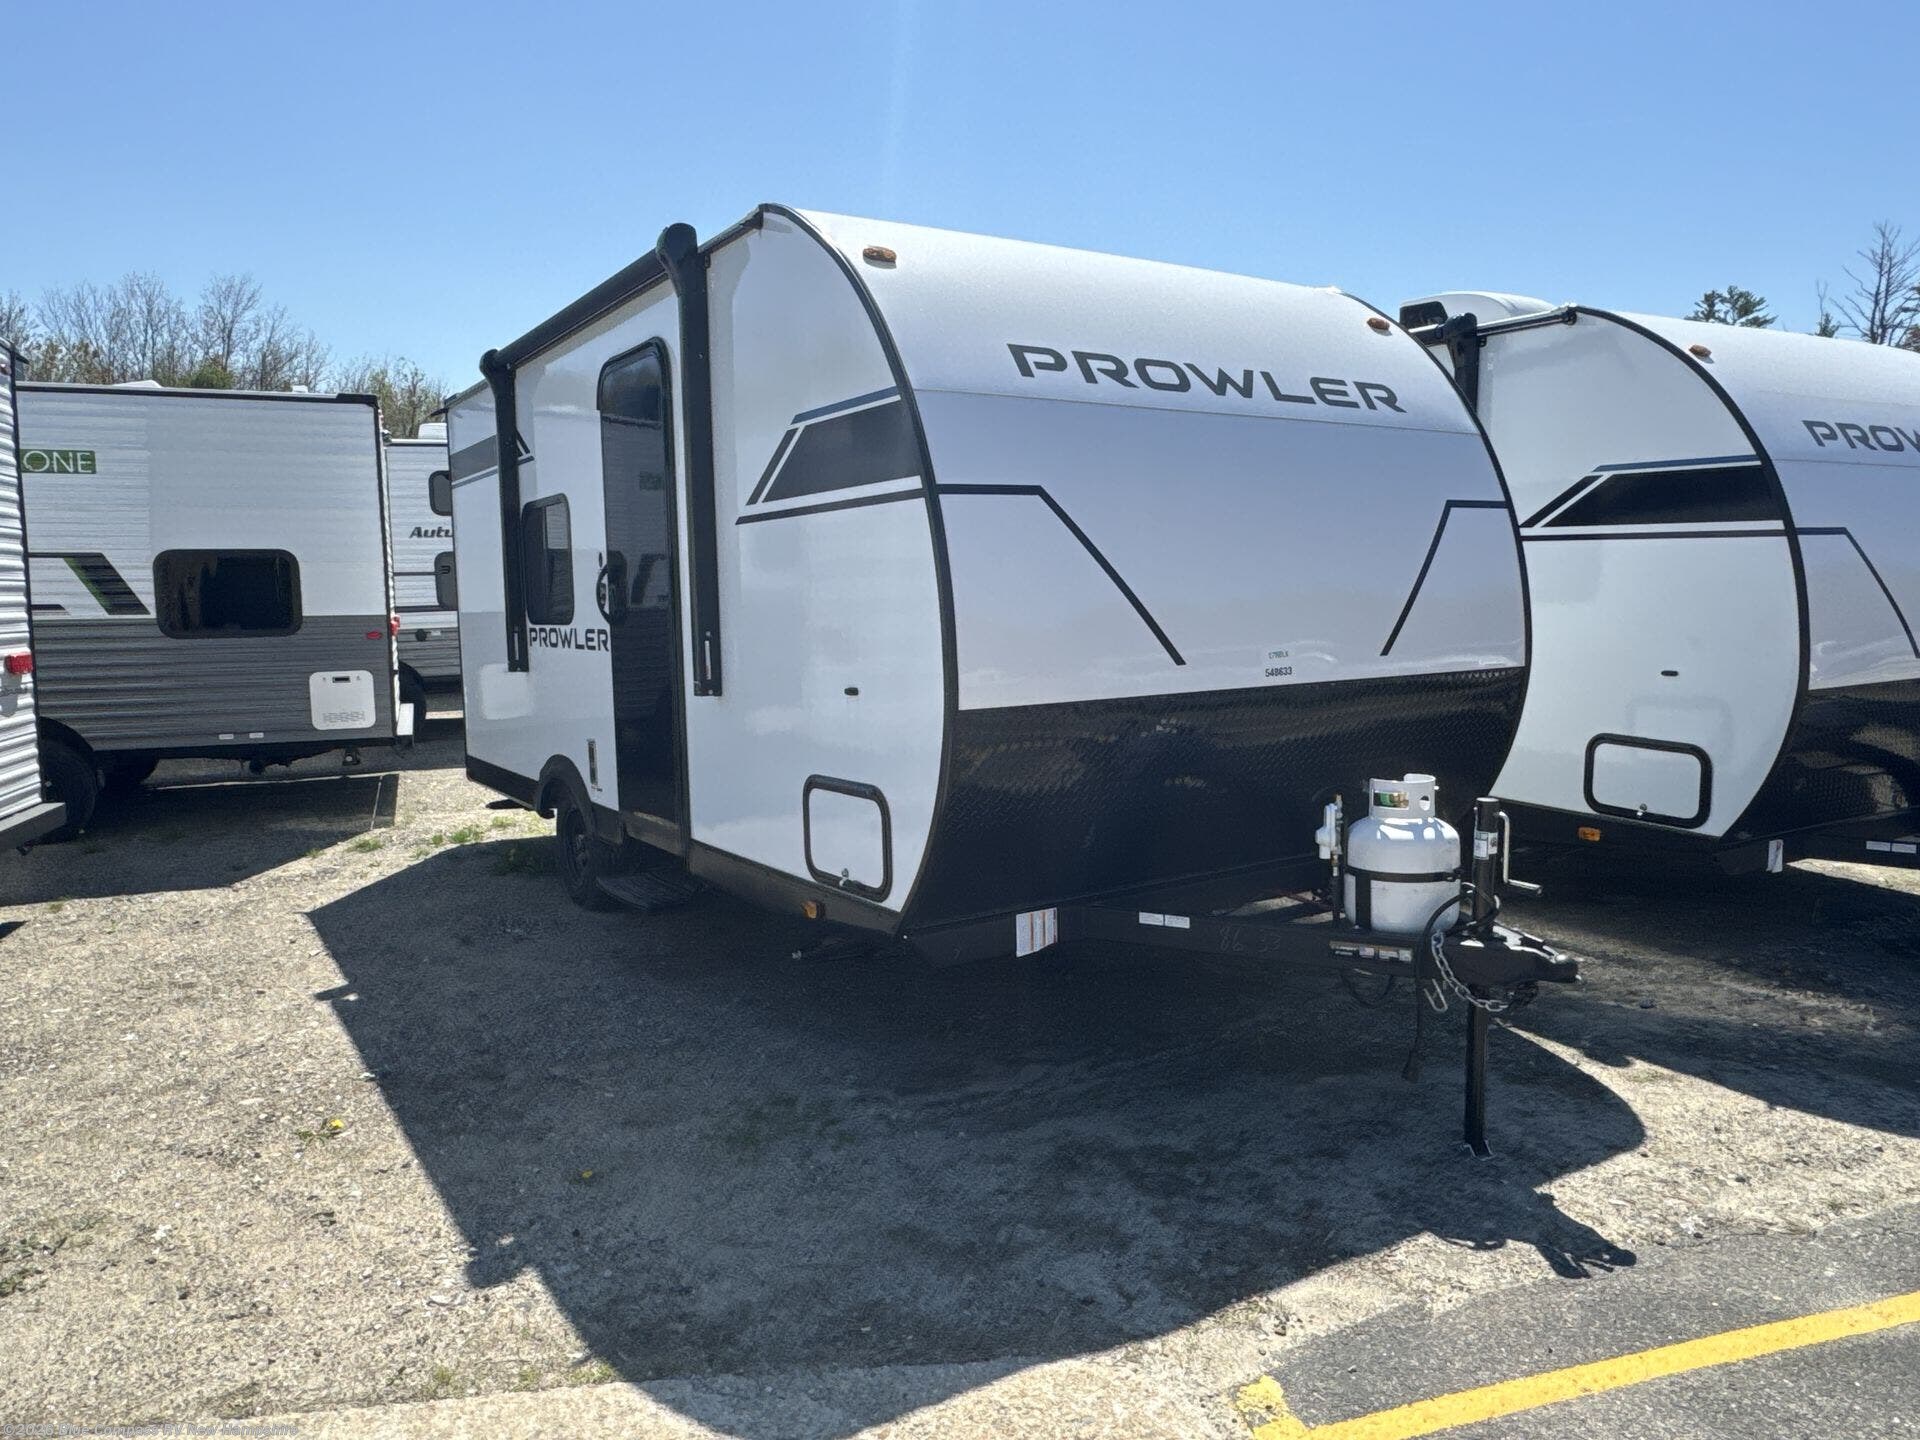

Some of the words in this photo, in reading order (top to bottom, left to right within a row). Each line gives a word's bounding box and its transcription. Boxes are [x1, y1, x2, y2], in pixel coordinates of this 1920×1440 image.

[1006, 343, 1408, 414] PROWLER
[22, 450, 92, 473] ONE
[528, 627, 610, 652] PROWLER
